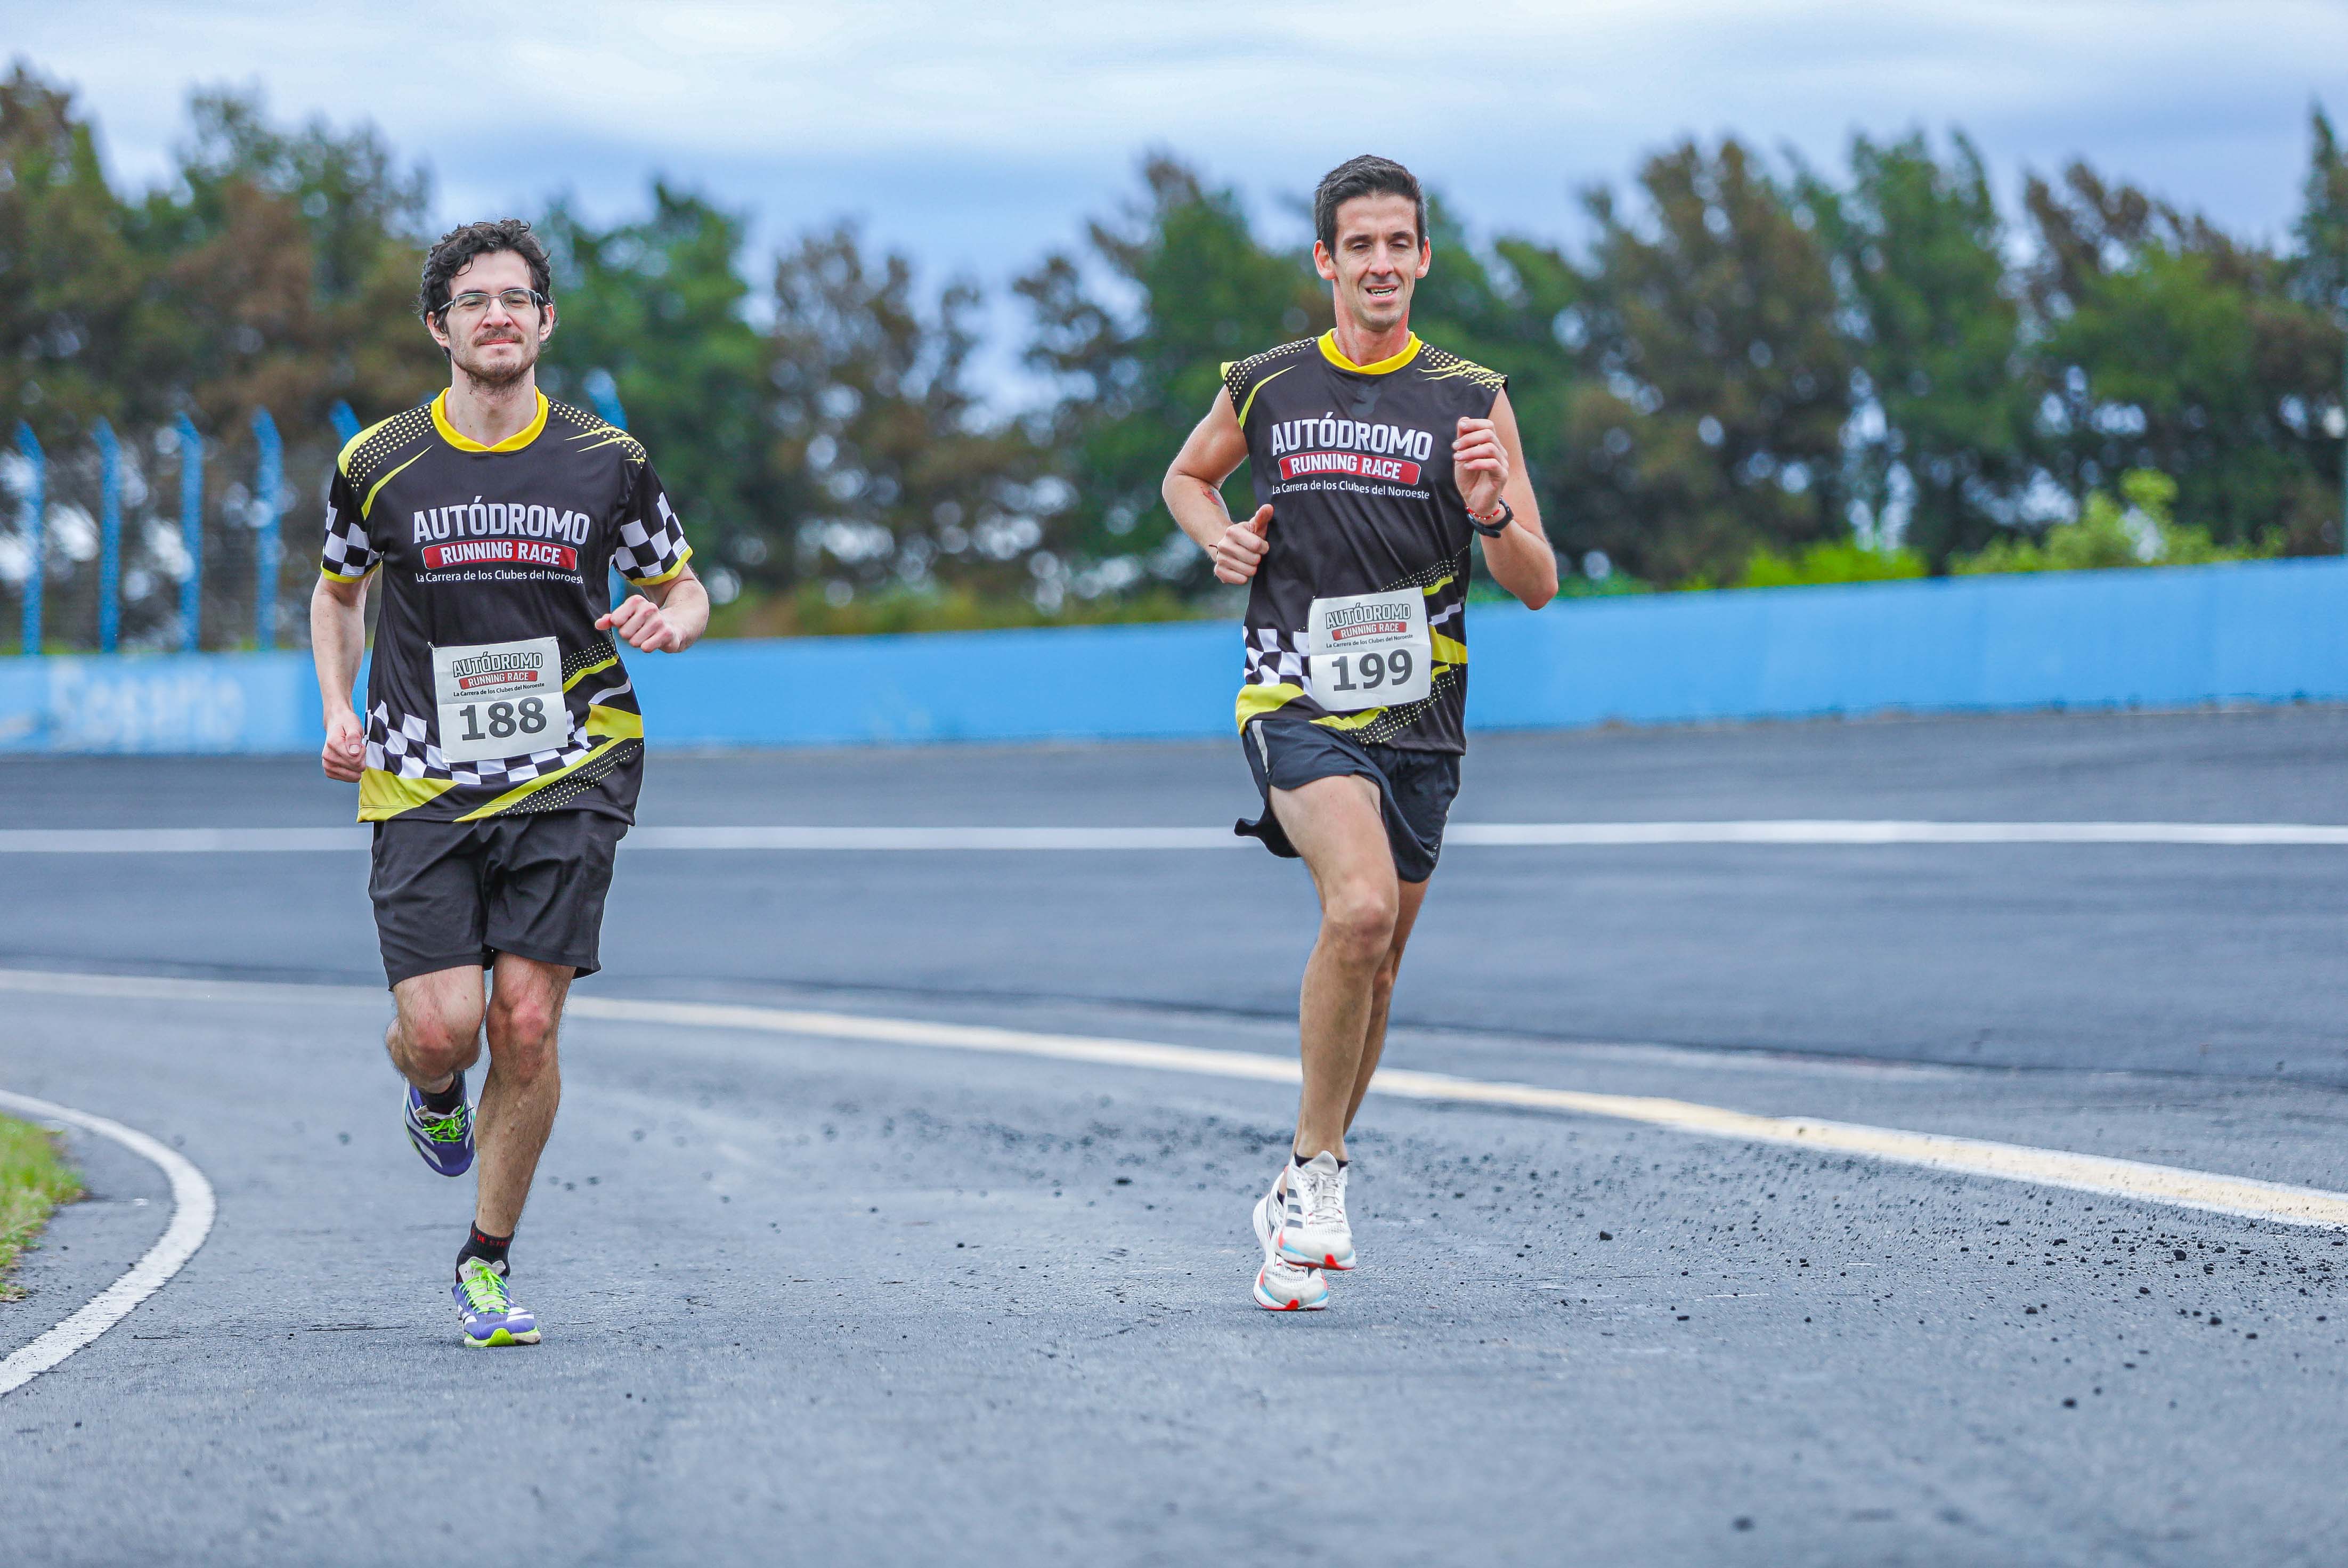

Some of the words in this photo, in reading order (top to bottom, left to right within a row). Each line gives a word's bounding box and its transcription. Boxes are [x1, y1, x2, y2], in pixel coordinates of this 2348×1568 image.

[1272, 411, 1433, 461] AUTÓDROMO
[1290, 453, 1358, 475] RUNNING
[1361, 457, 1402, 480] RACE
[1272, 485, 1281, 494] La
[1281, 483, 1308, 493] Carrera
[1310, 480, 1321, 490] de
[1323, 480, 1337, 490] los
[1339, 481, 1369, 493] Clubes
[1371, 485, 1386, 495] del
[1388, 486, 1429, 499] Noroeste
[413, 495, 591, 545] AUTÓDROMO
[440, 541, 513, 565] RUNNING
[517, 542, 562, 565] RACE
[415, 573, 425, 582] La
[426, 572, 461, 582] Carrera
[464, 570, 476, 580] de
[478, 570, 493, 580] los
[494, 570, 527, 580] Clubes
[530, 570, 545, 580] del
[547, 571, 584, 584] Noroest
[1325, 603, 1411, 629] AUTÓDROMO
[1340, 624, 1377, 638] RUNNING
[1379, 623, 1399, 632] RACE
[452, 652, 543, 678] AUTÓDROMO
[1332, 648, 1413, 692] 199
[468, 673, 505, 687] RUNNING
[507, 671, 529, 681] RACE
[459, 696, 547, 741] 188
